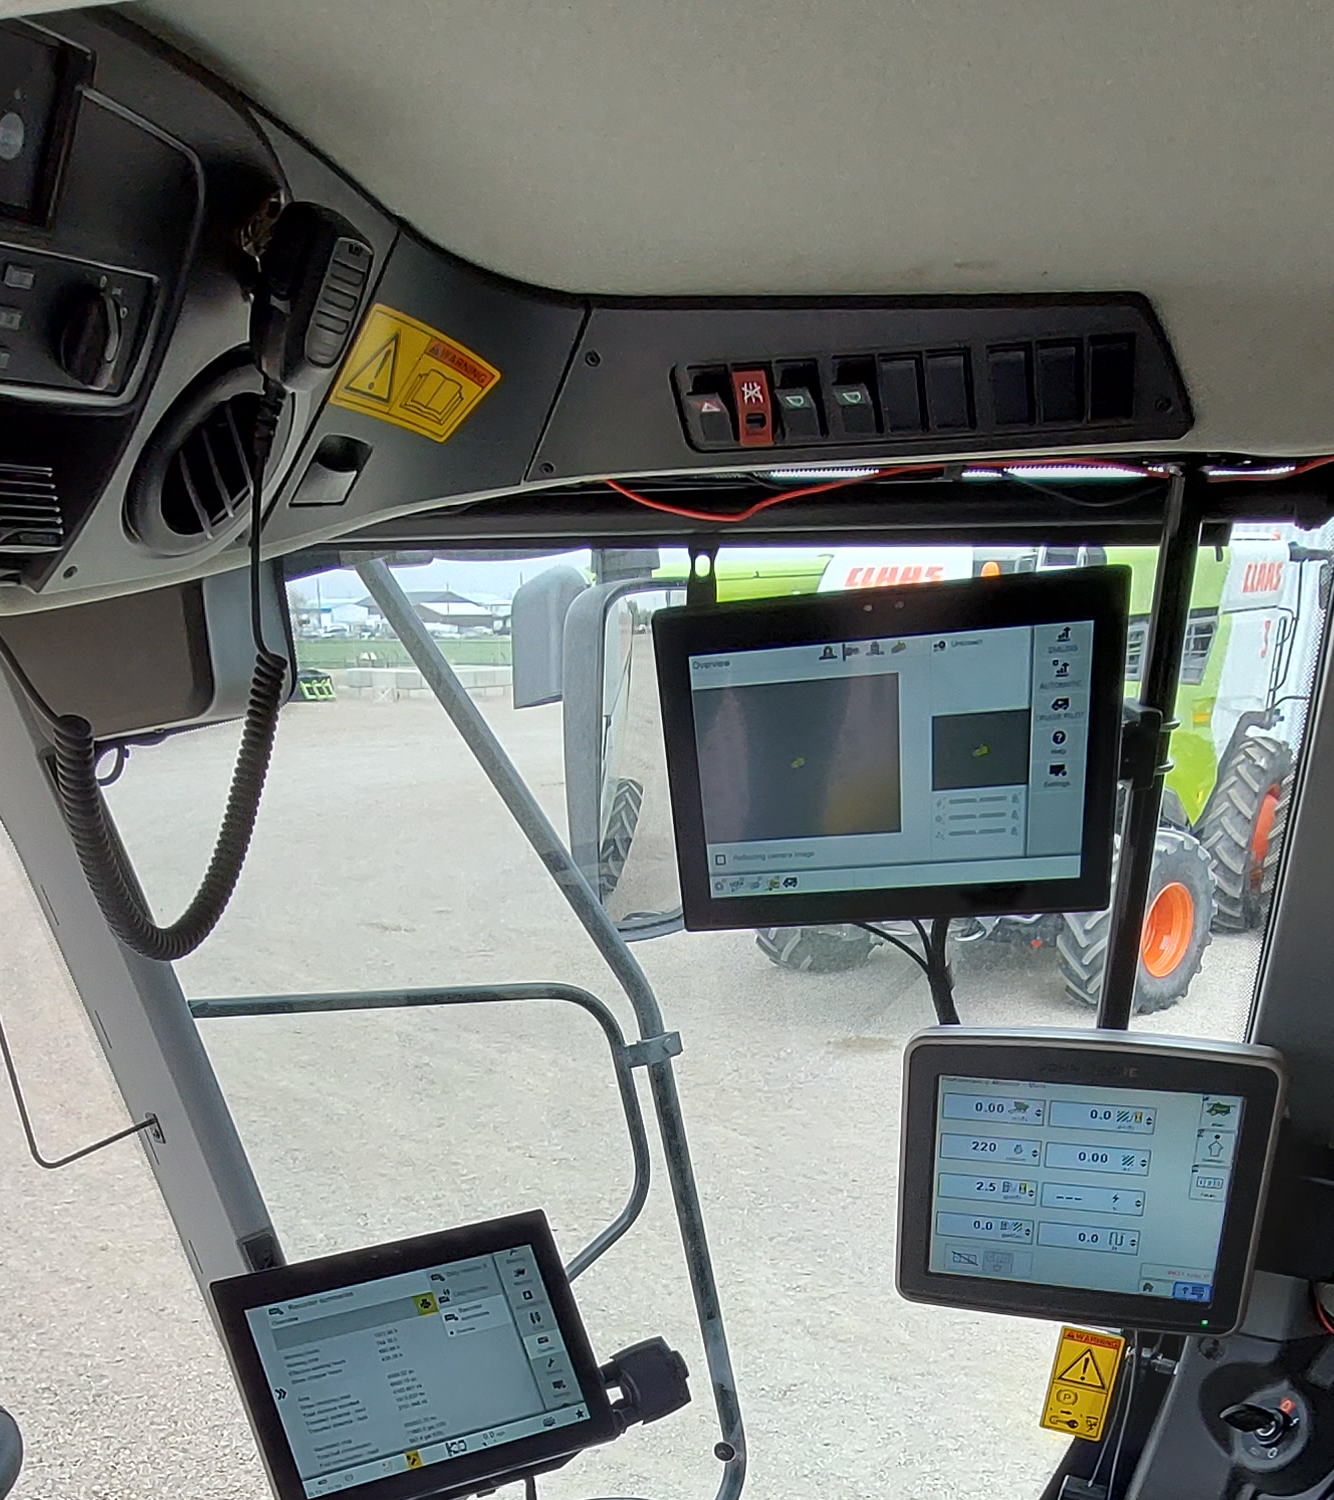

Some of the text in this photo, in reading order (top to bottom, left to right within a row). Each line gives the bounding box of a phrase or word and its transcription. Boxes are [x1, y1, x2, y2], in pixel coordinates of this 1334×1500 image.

[440, 348, 488, 384] WARNING
[845, 566, 944, 588] CLAAS
[1242, 562, 1283, 594] CLAAS
[692, 660, 730, 670] Overview
[975, 1101, 1005, 1113] 0.00
[1090, 1109, 1112, 1120] 0.0
[971, 1141, 997, 1152] 220
[1078, 1151, 1108, 1163] 0.00
[976, 1181, 997, 1192] 2.5
[973, 1220, 993, 1231] 0.0
[1078, 1232, 1099, 1243] 0.0
